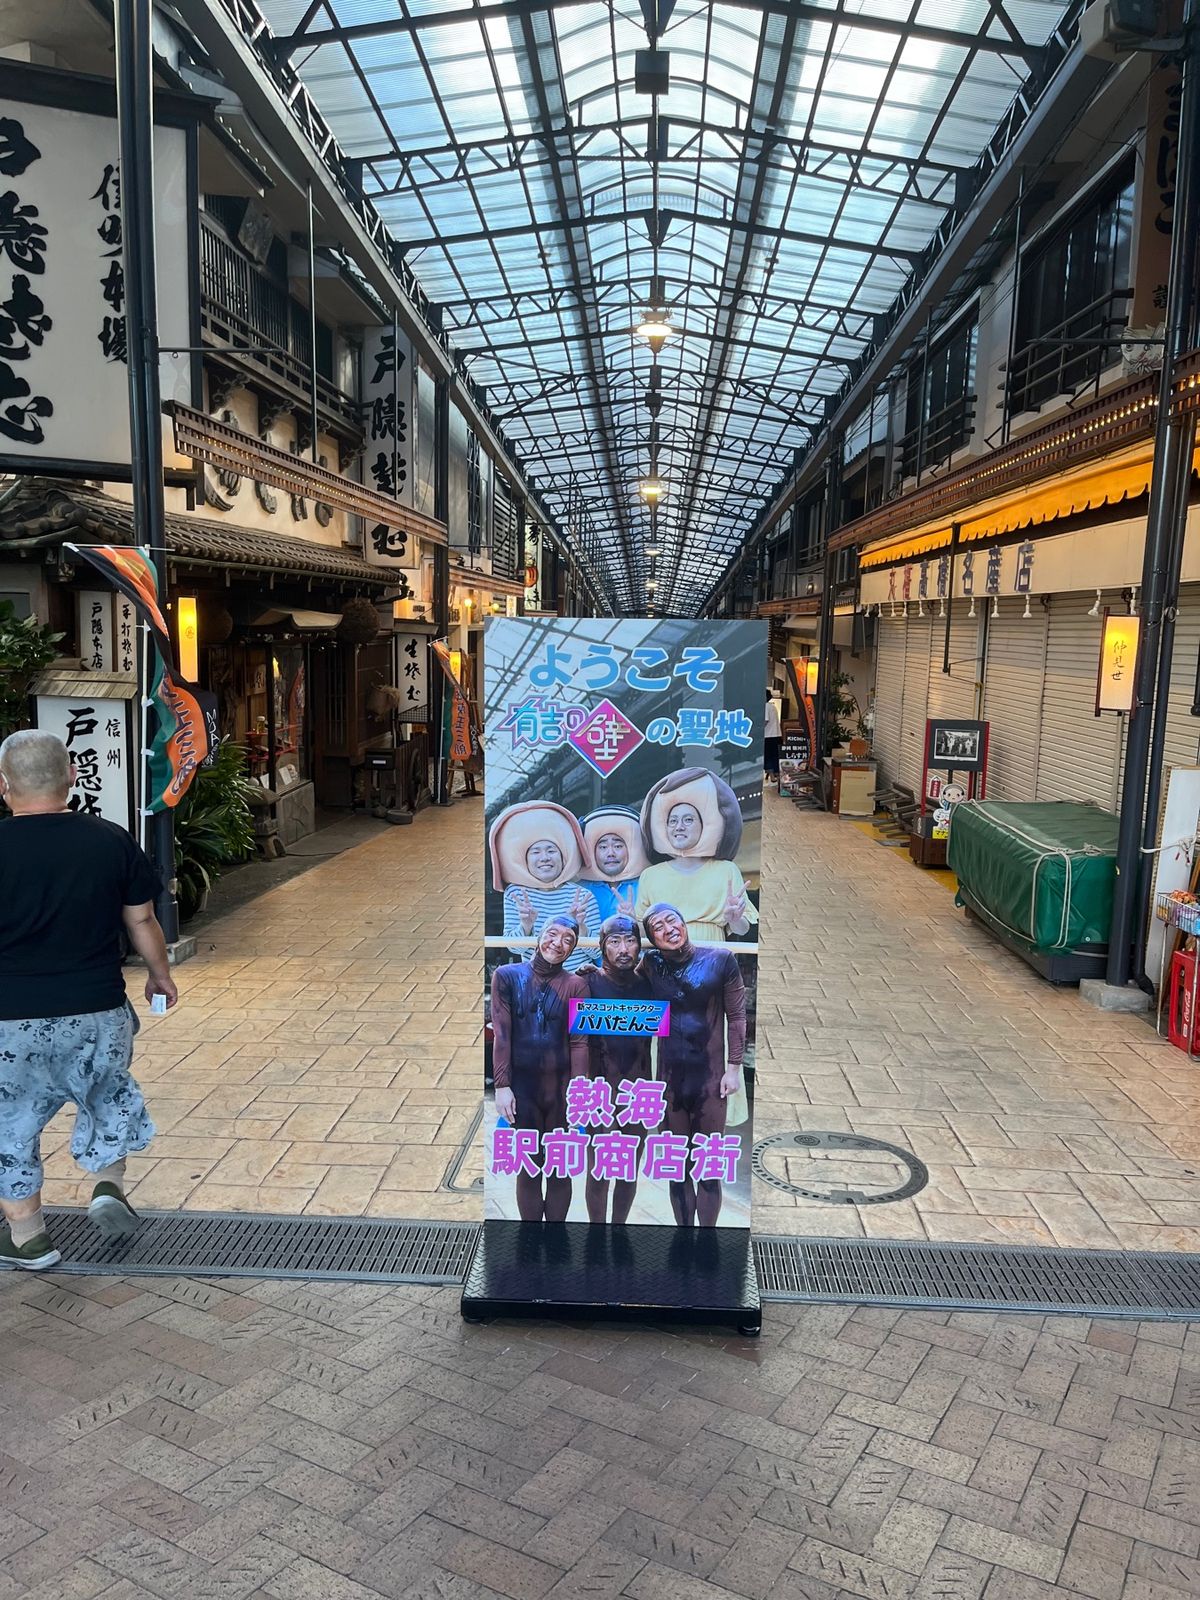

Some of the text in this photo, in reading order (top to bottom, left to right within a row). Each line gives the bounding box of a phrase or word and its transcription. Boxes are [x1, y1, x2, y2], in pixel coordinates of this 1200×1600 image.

[91, 602, 104, 669] 戸隠本店
[1111, 639, 1128, 681] 仲見世
[528, 643, 726, 693] ようこそ
[105, 718, 121, 769] 信州
[577, 1002, 662, 1013] 新マスコットキャラクター
[578, 1014, 661, 1032] パパだんご
[566, 1076, 667, 1129] 熱海
[491, 1128, 742, 1184] 駅前商店街
